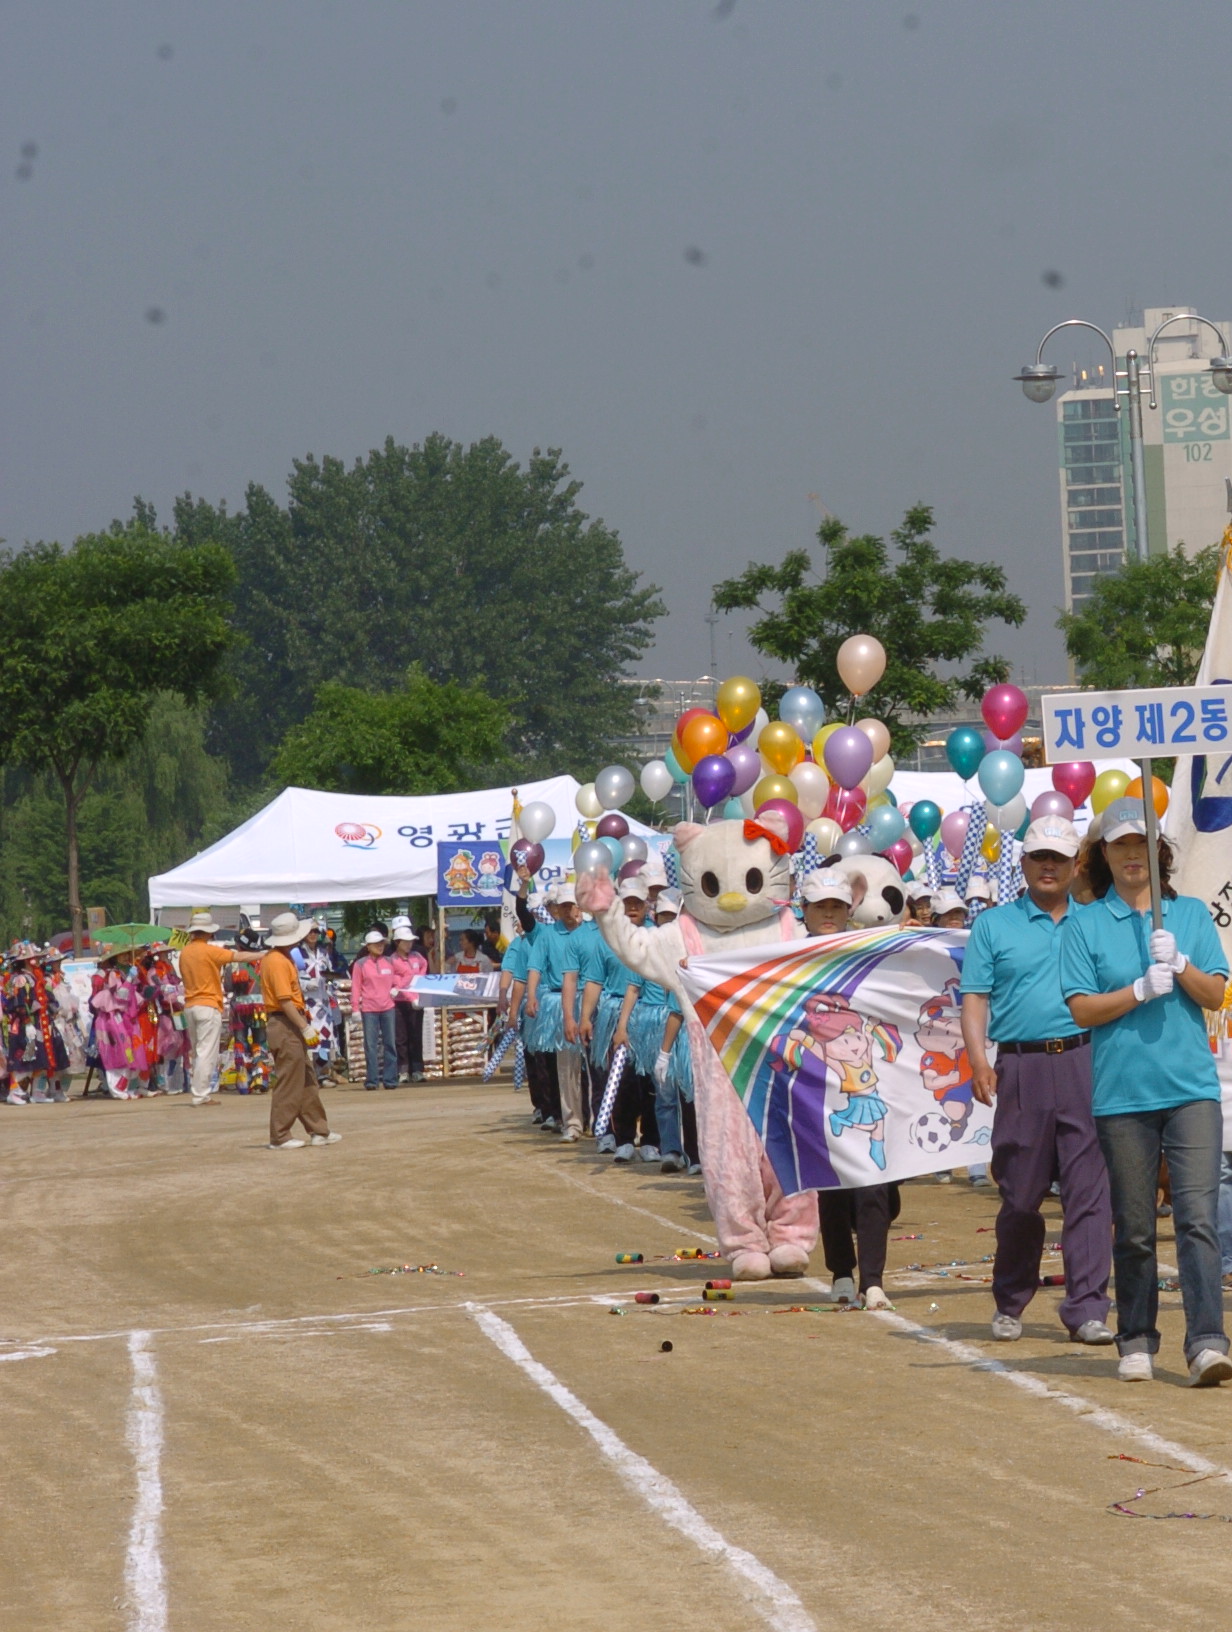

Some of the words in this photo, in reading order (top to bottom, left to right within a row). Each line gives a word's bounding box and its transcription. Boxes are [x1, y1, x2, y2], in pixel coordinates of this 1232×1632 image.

[1165, 406, 1227, 438] 우성
[1182, 443, 1213, 463] 102
[1054, 704, 1123, 749] 자양
[1134, 698, 1228, 744] 제2동
